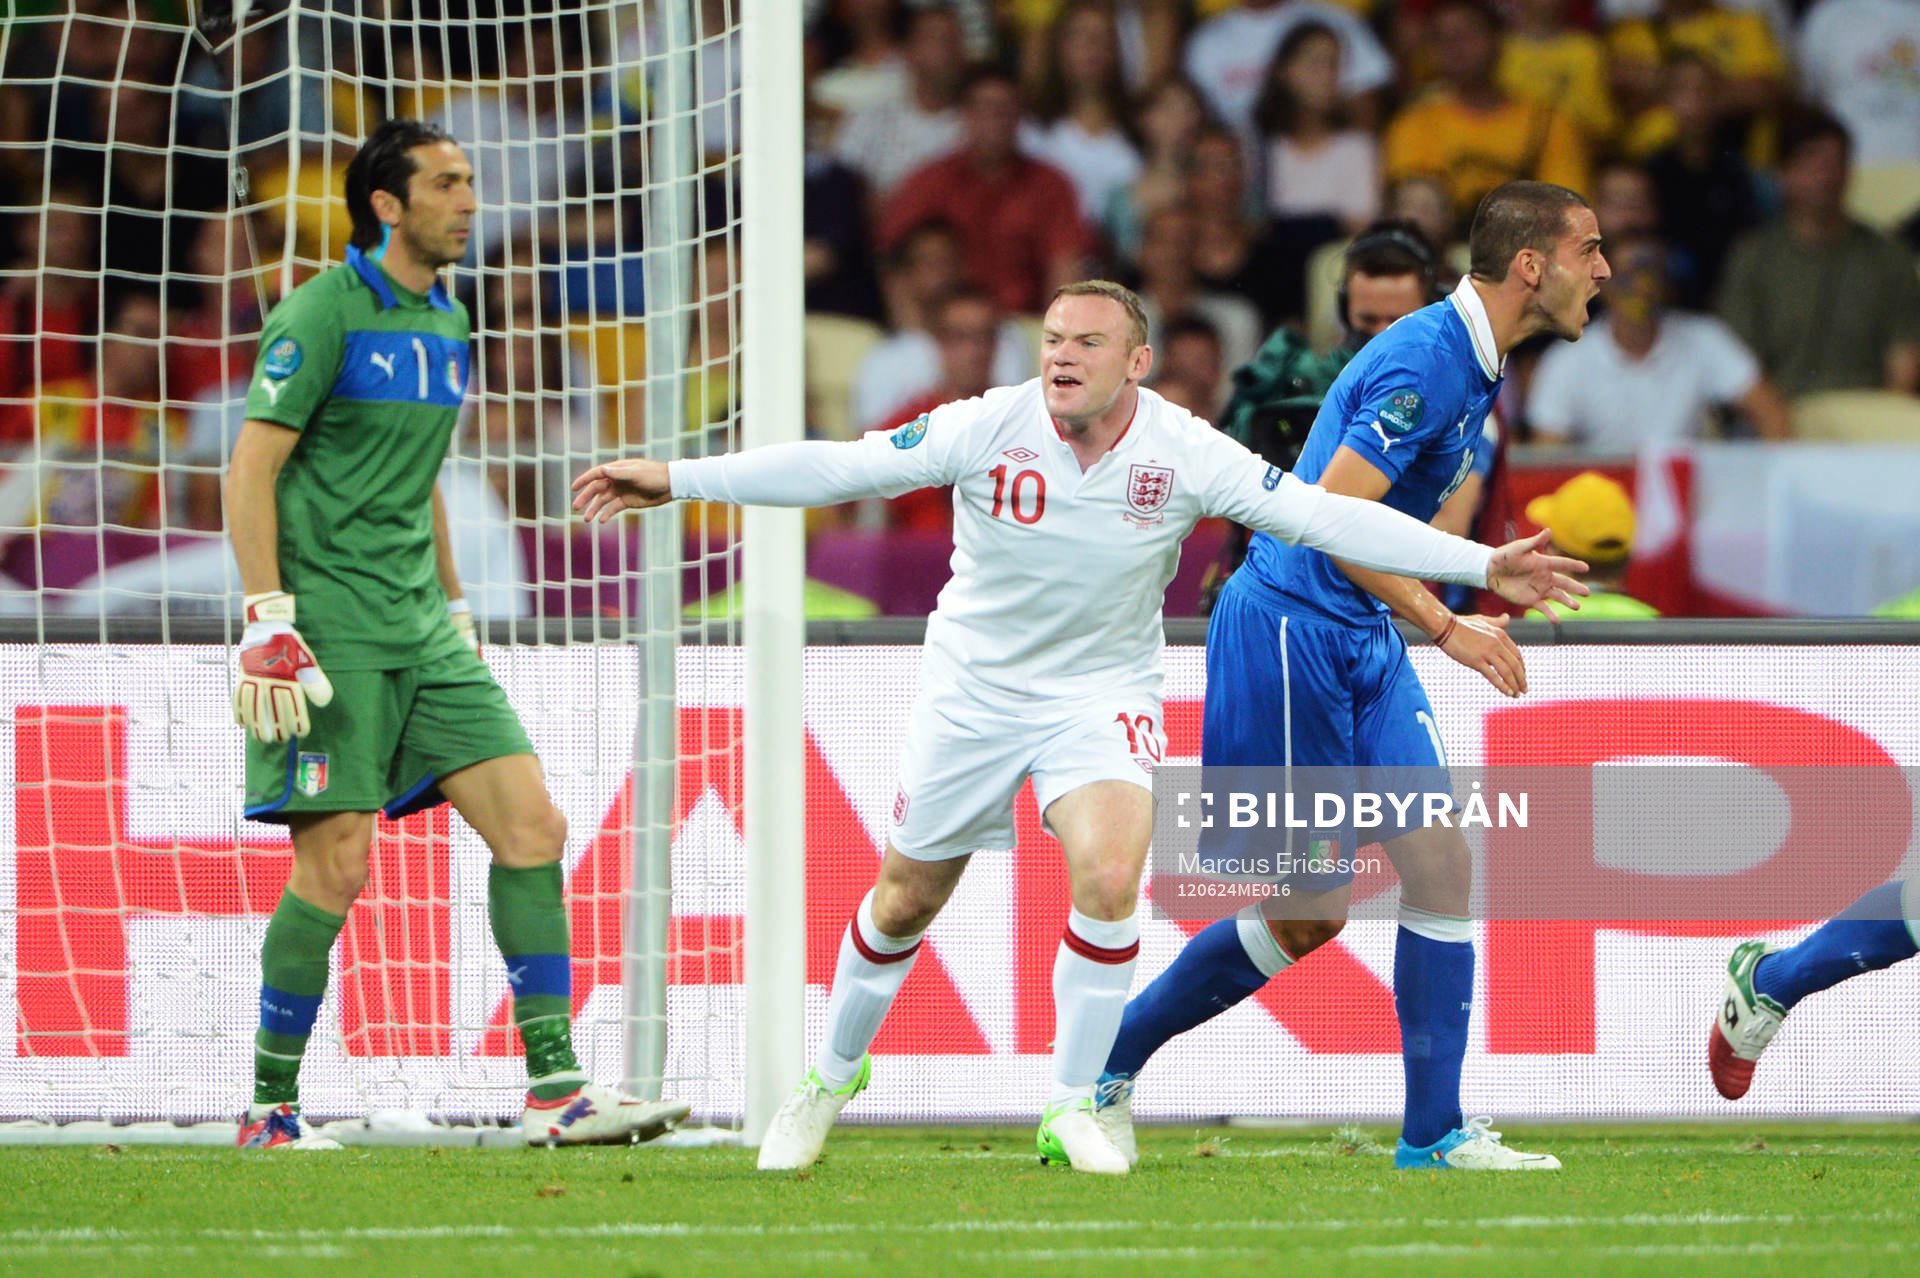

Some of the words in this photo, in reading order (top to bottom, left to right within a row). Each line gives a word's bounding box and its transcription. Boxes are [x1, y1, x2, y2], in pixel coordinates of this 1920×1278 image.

[412, 337, 428, 399] 1
[988, 463, 1046, 524] 10
[1113, 712, 1161, 763] 10
